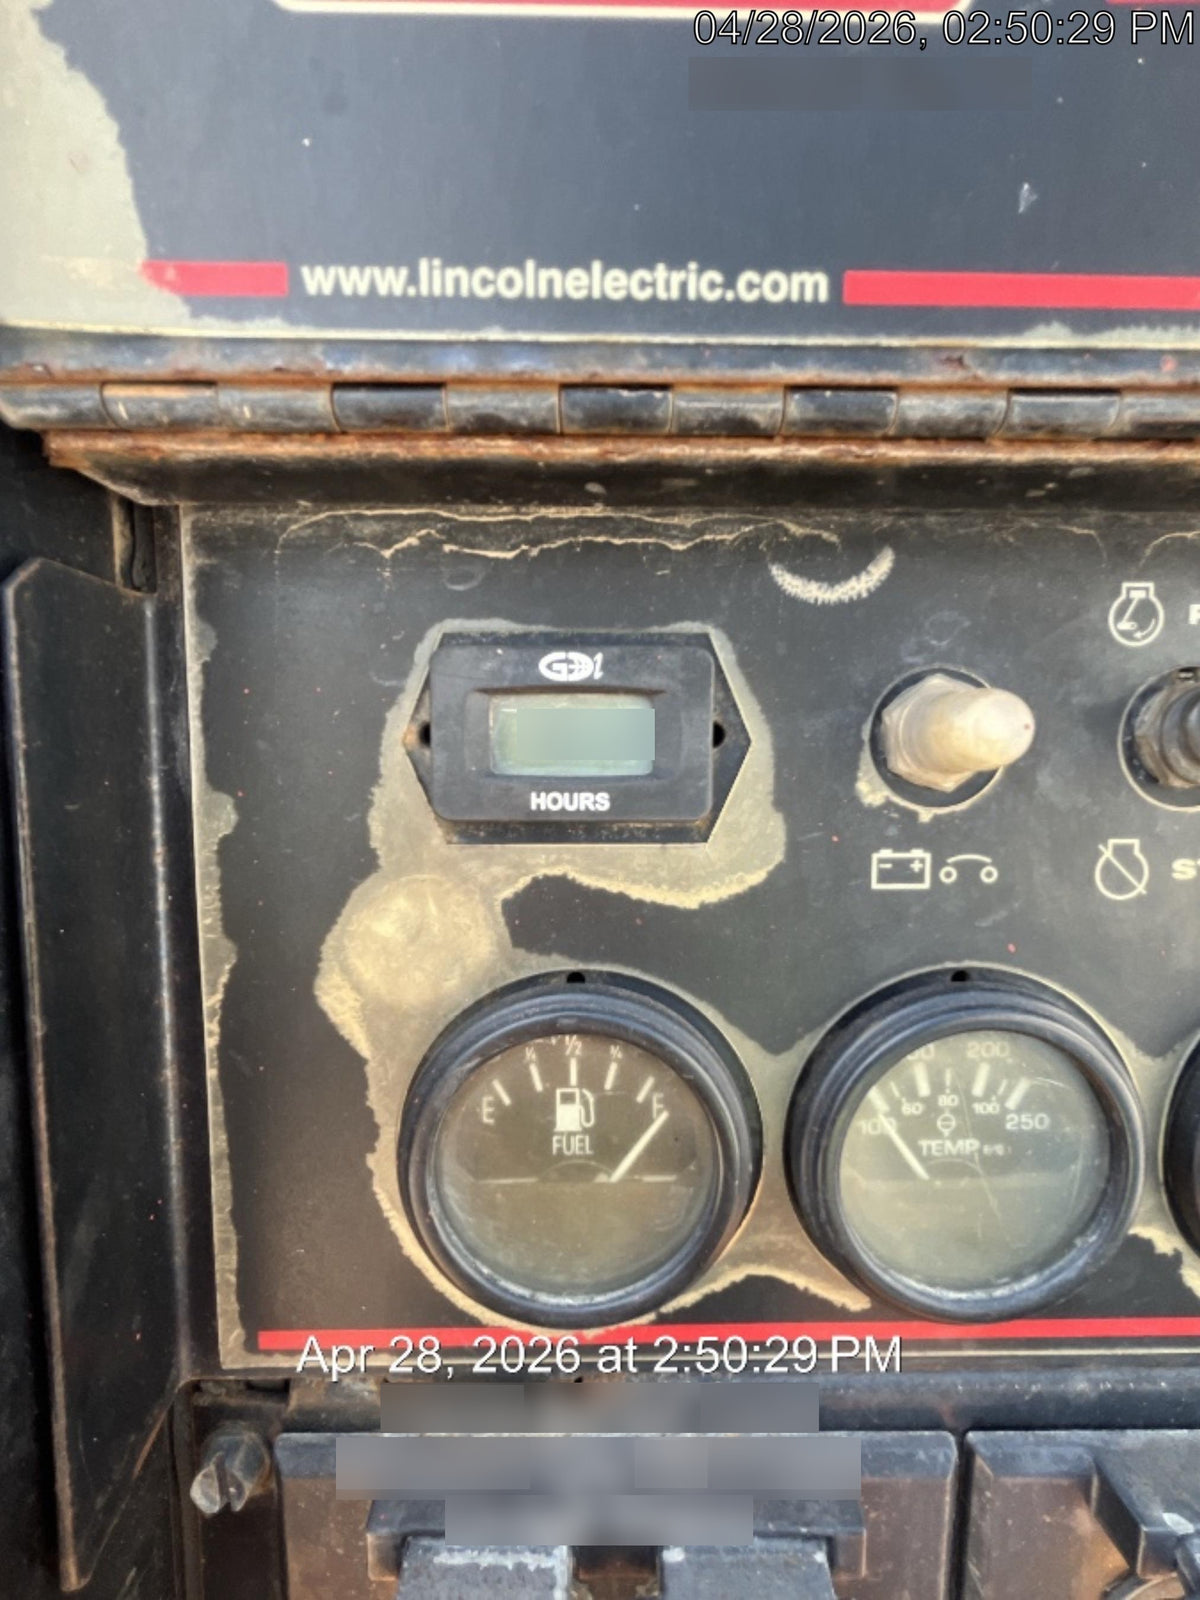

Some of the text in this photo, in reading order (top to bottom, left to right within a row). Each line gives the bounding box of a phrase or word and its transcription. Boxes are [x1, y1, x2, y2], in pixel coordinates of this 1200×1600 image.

[301, 258, 829, 303] www.lincolnelectric.com
[530, 791, 611, 812] HOURS
[1171, 858, 1200, 880] S
[966, 1041, 1010, 1059] 200
[482, 1096, 495, 1125] E
[652, 1092, 665, 1119] F
[972, 1102, 1000, 1115] 100
[1005, 1112, 1050, 1130] 250
[552, 1134, 594, 1156] FUEL
[918, 1138, 980, 1155] TEMP
